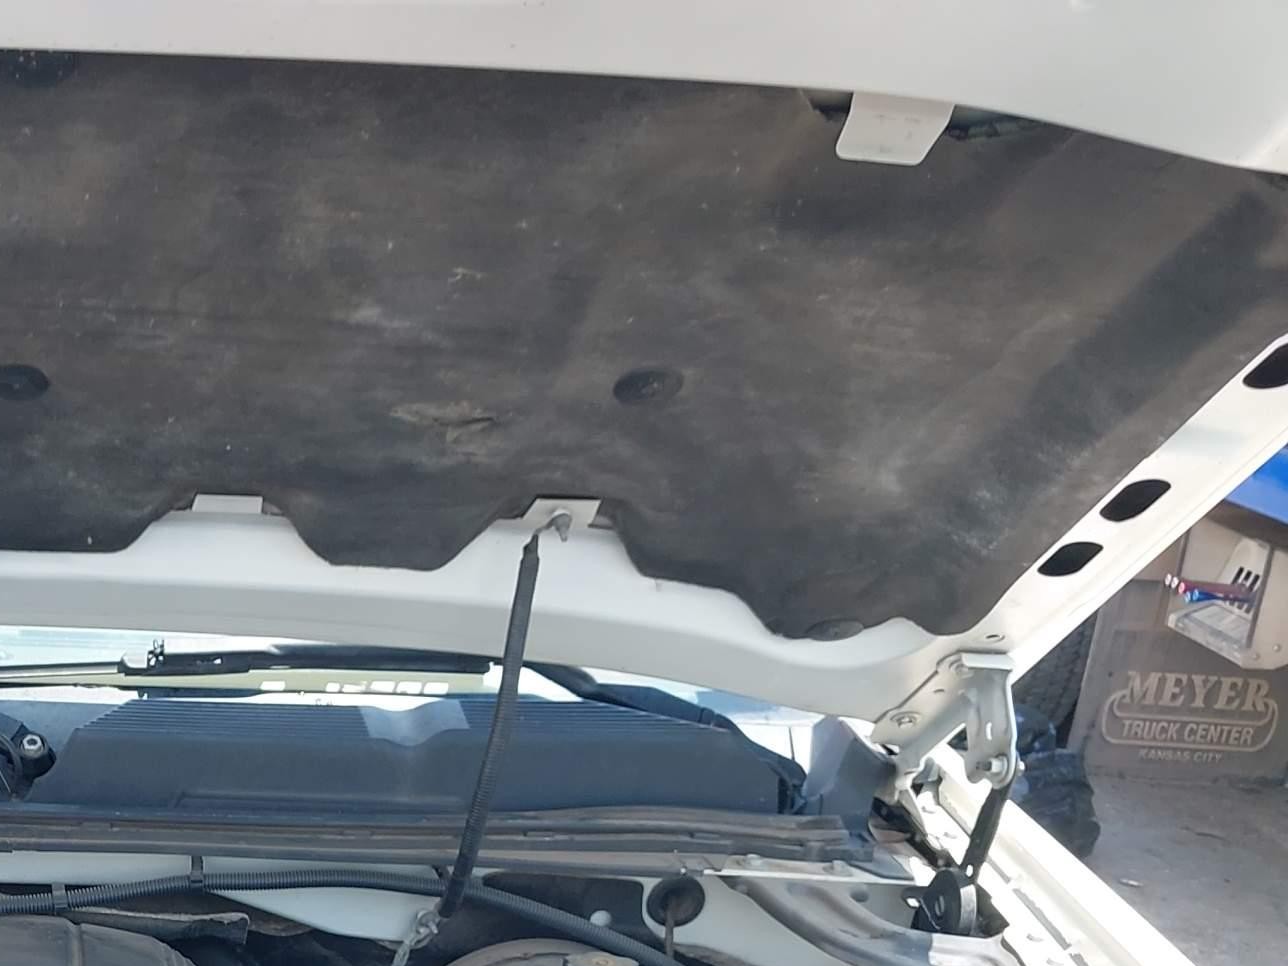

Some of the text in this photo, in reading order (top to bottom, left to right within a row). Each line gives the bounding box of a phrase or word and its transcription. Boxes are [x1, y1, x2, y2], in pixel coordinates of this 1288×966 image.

[1122, 671, 1270, 713] MEYER
[1122, 719, 1254, 746] TRUCK CENTER
[1139, 748, 1224, 763] KANSAS CITY
